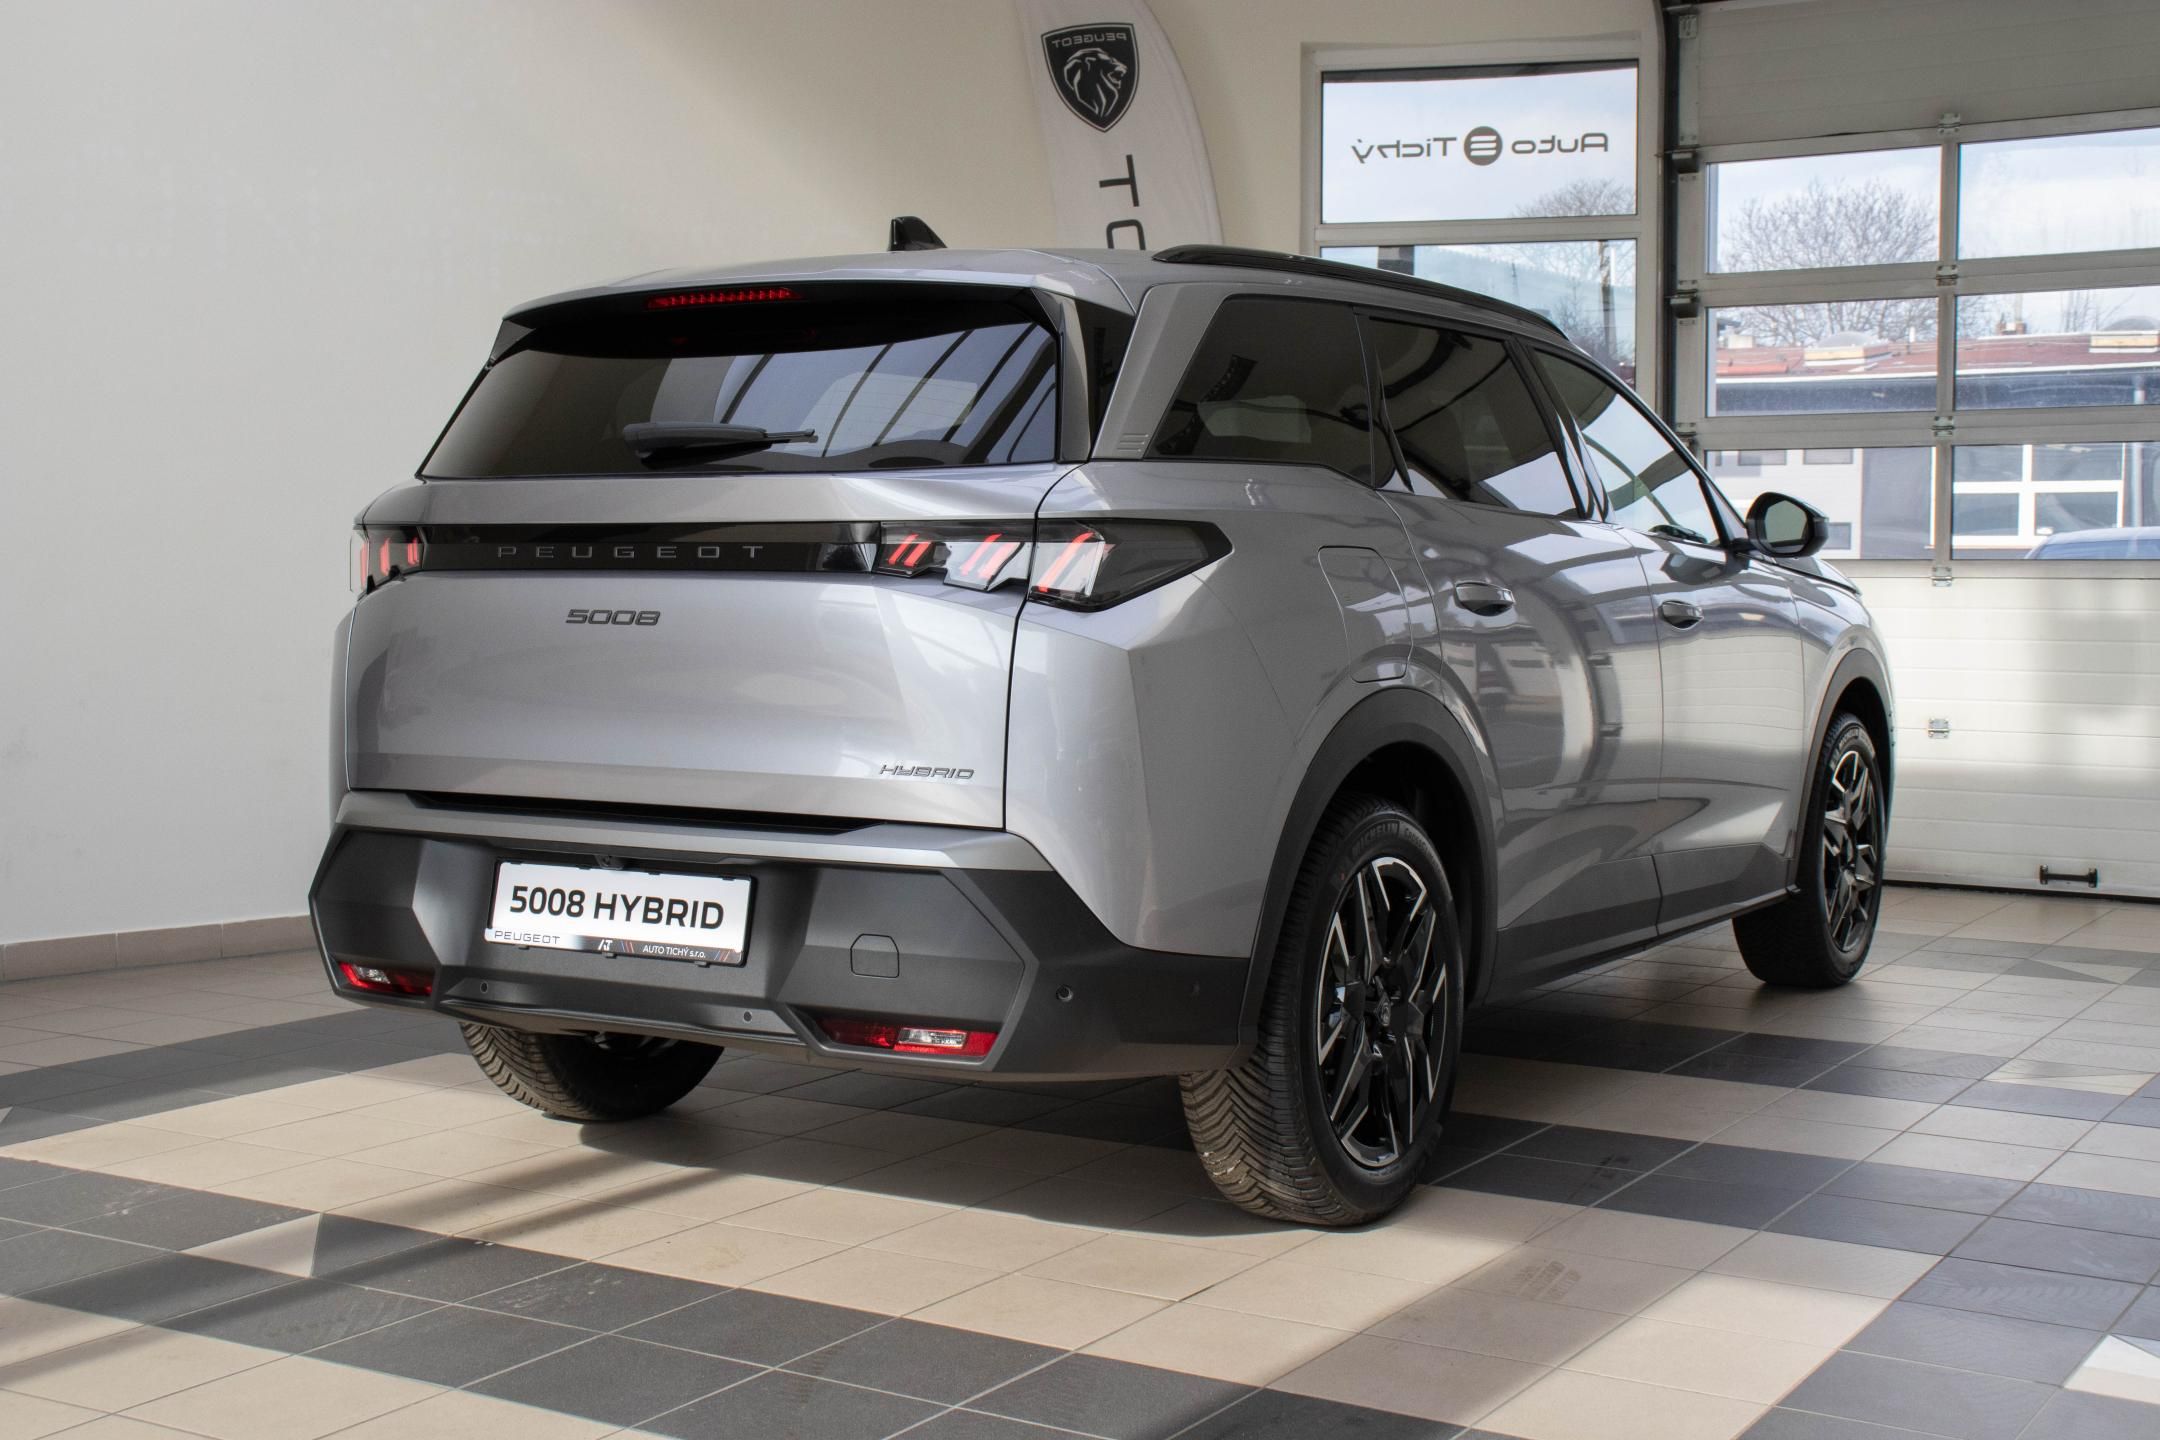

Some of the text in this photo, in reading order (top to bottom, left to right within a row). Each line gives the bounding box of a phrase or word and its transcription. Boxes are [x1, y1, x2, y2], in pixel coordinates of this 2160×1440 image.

[497, 545, 764, 559] PEUGEOT
[565, 608, 662, 626] 5008
[879, 764, 975, 780] HYBRID
[1352, 822, 1399, 857] MICHELIN
[509, 885, 725, 930] 5008 HYBRID
[494, 929, 561, 946] PEUGEOT
[642, 944, 665, 954] AUTO
[665, 945, 689, 957] TICHÝ
